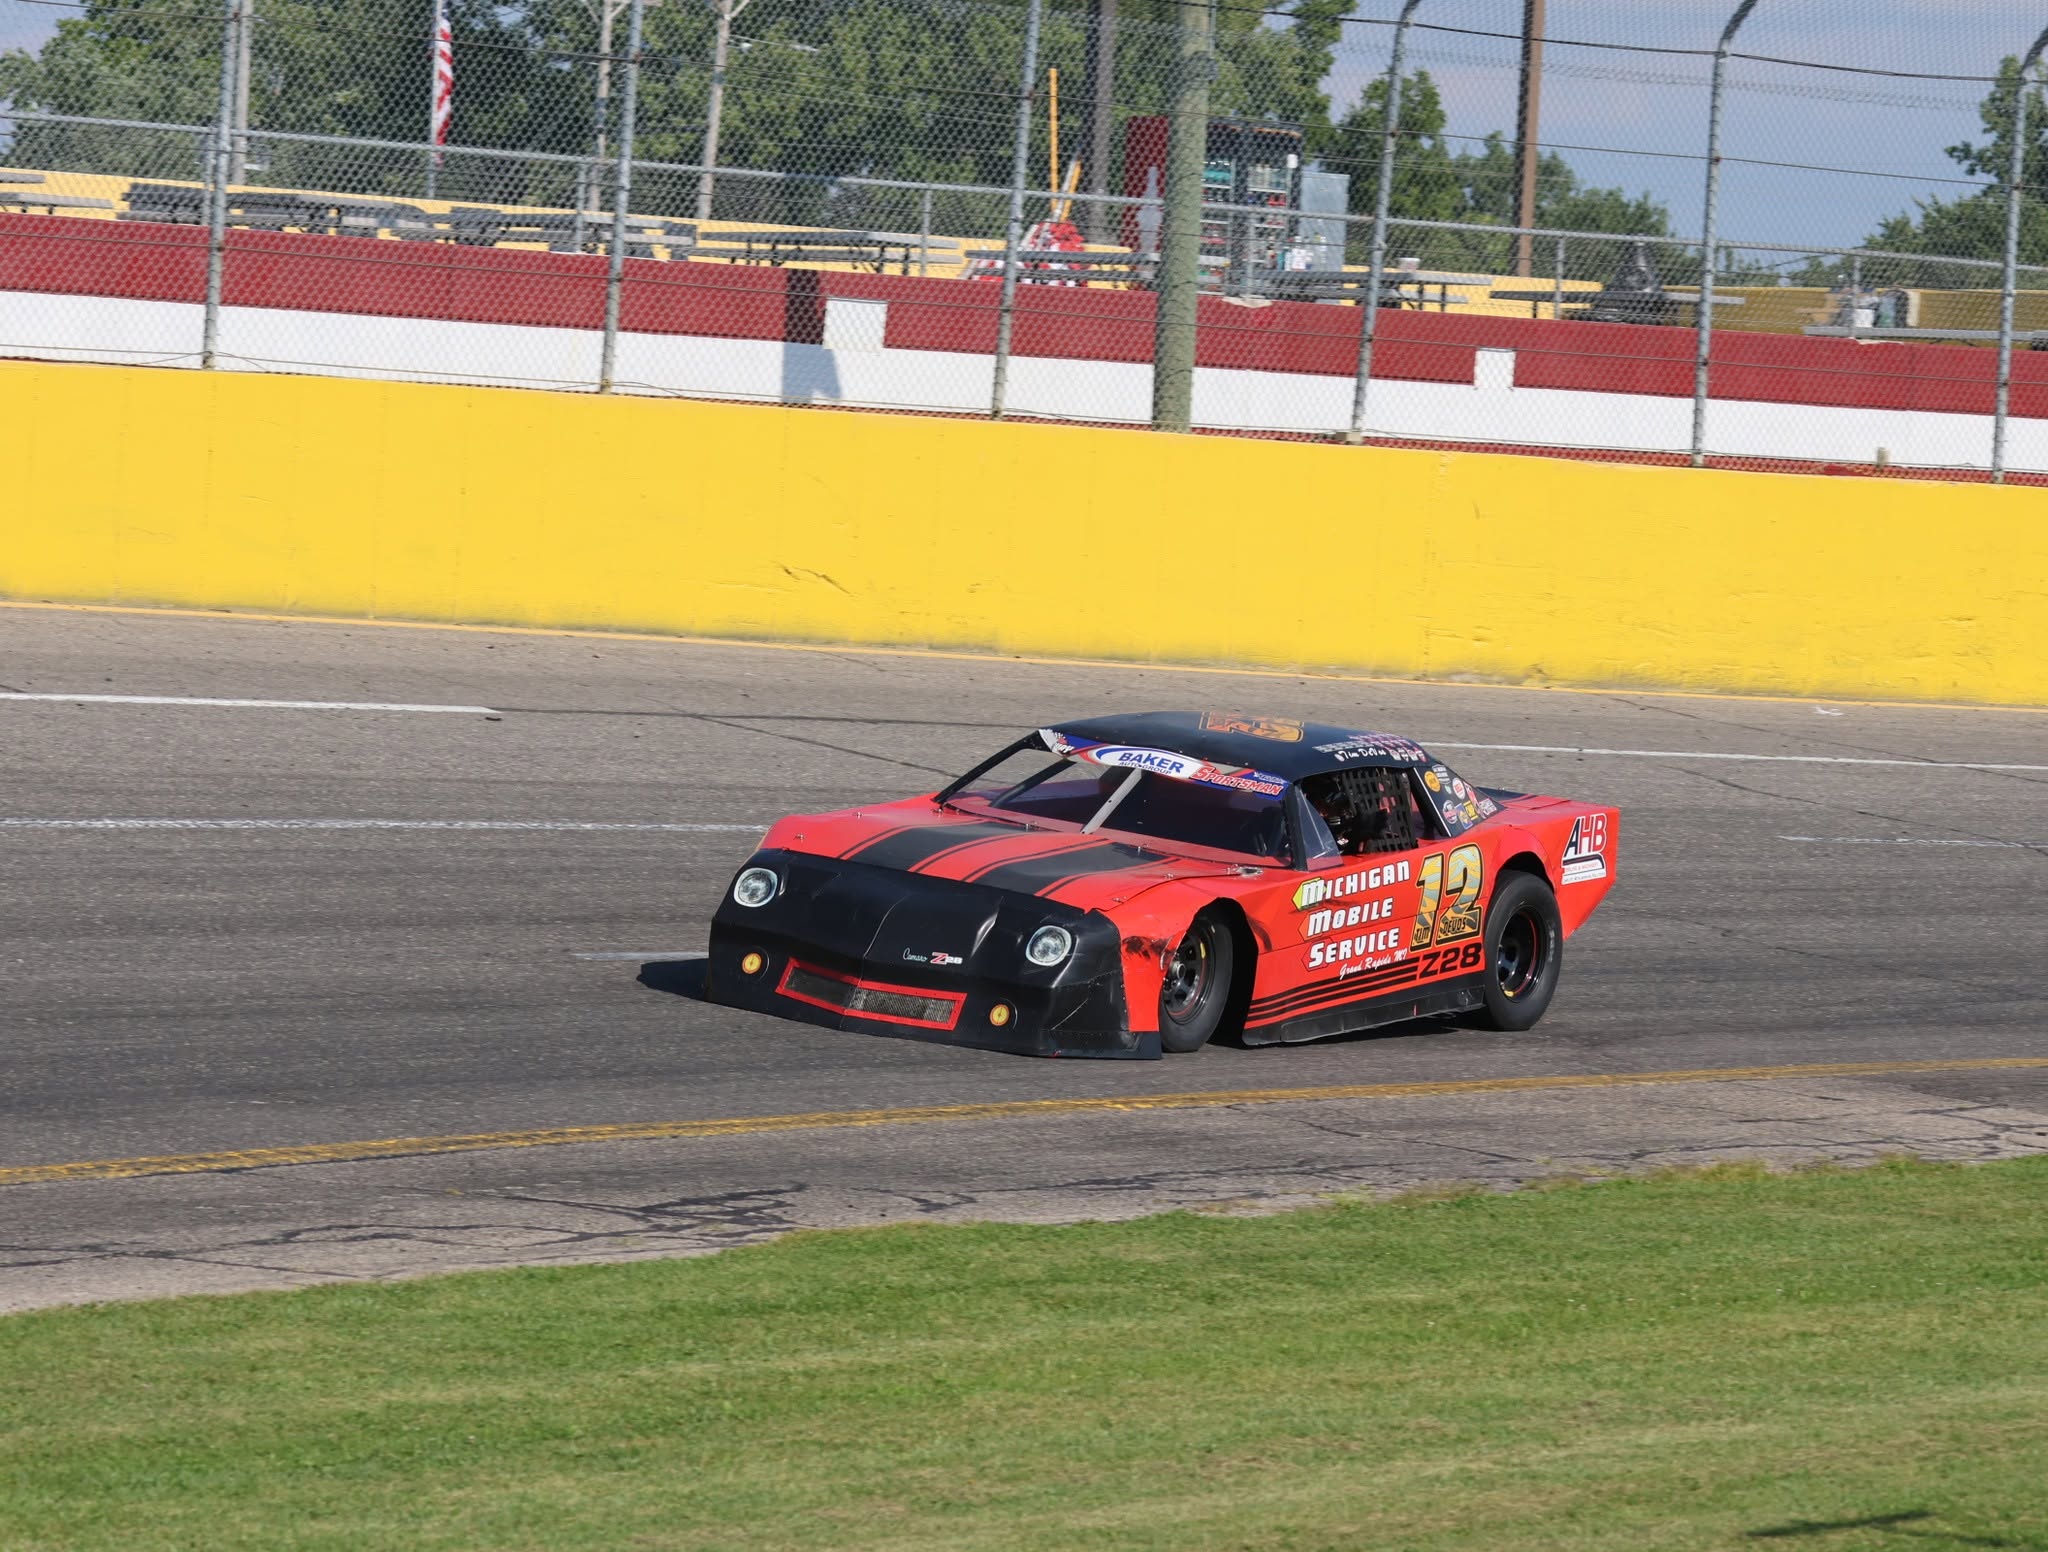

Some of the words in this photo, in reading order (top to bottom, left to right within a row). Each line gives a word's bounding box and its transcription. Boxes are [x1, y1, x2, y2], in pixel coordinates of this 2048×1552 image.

[1118, 752, 1184, 773] BAKER
[1118, 760, 1141, 769] AUTO
[1143, 763, 1172, 776] GROUP
[1191, 766, 1285, 796] SPORTSMAN
[1562, 813, 1607, 858] AHB
[1301, 860, 1410, 907] MICHIGAN
[1409, 843, 1483, 953] 12
[1307, 897, 1394, 938] MOBILE
[1308, 927, 1400, 969] SERVICE
[1339, 960, 1363, 981] Grand
[1364, 954, 1392, 971] Rapids
[1418, 943, 1482, 980] Z28
